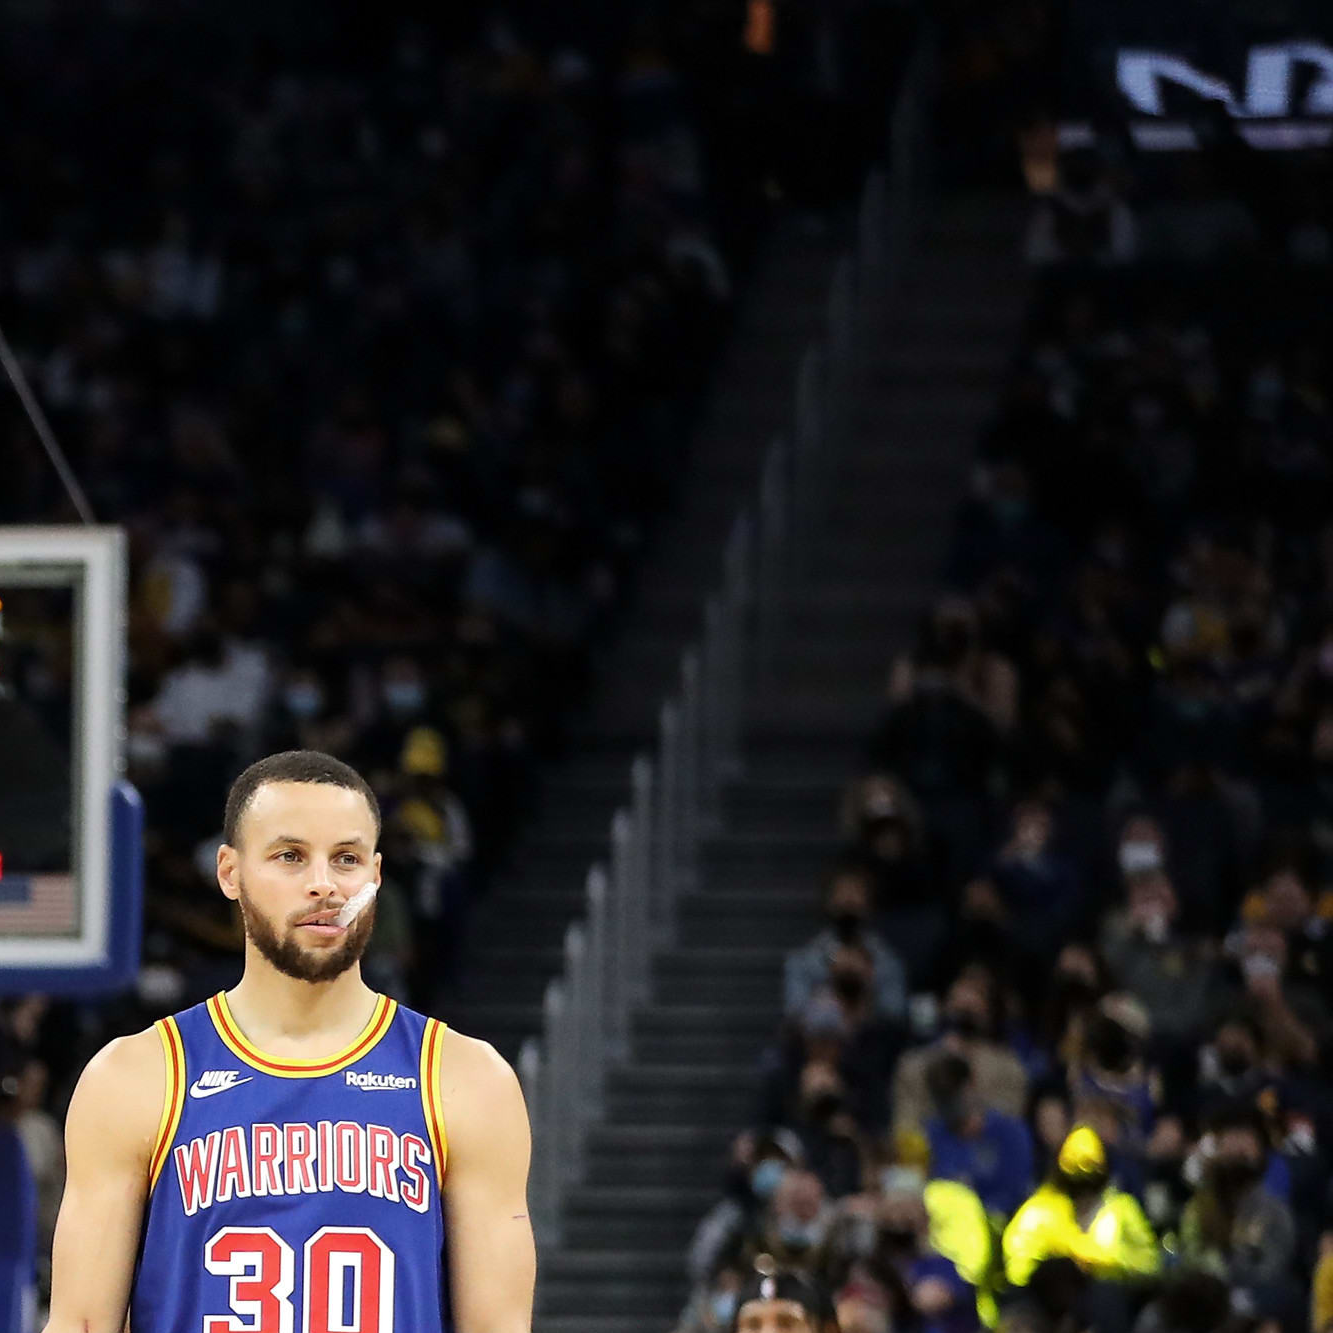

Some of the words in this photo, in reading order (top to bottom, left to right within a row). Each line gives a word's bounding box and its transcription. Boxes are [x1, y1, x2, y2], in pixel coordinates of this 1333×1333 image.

[199, 1070, 240, 1087] NIKE
[346, 1071, 417, 1090] Rakuten
[174, 1120, 432, 1217] WARRIORS
